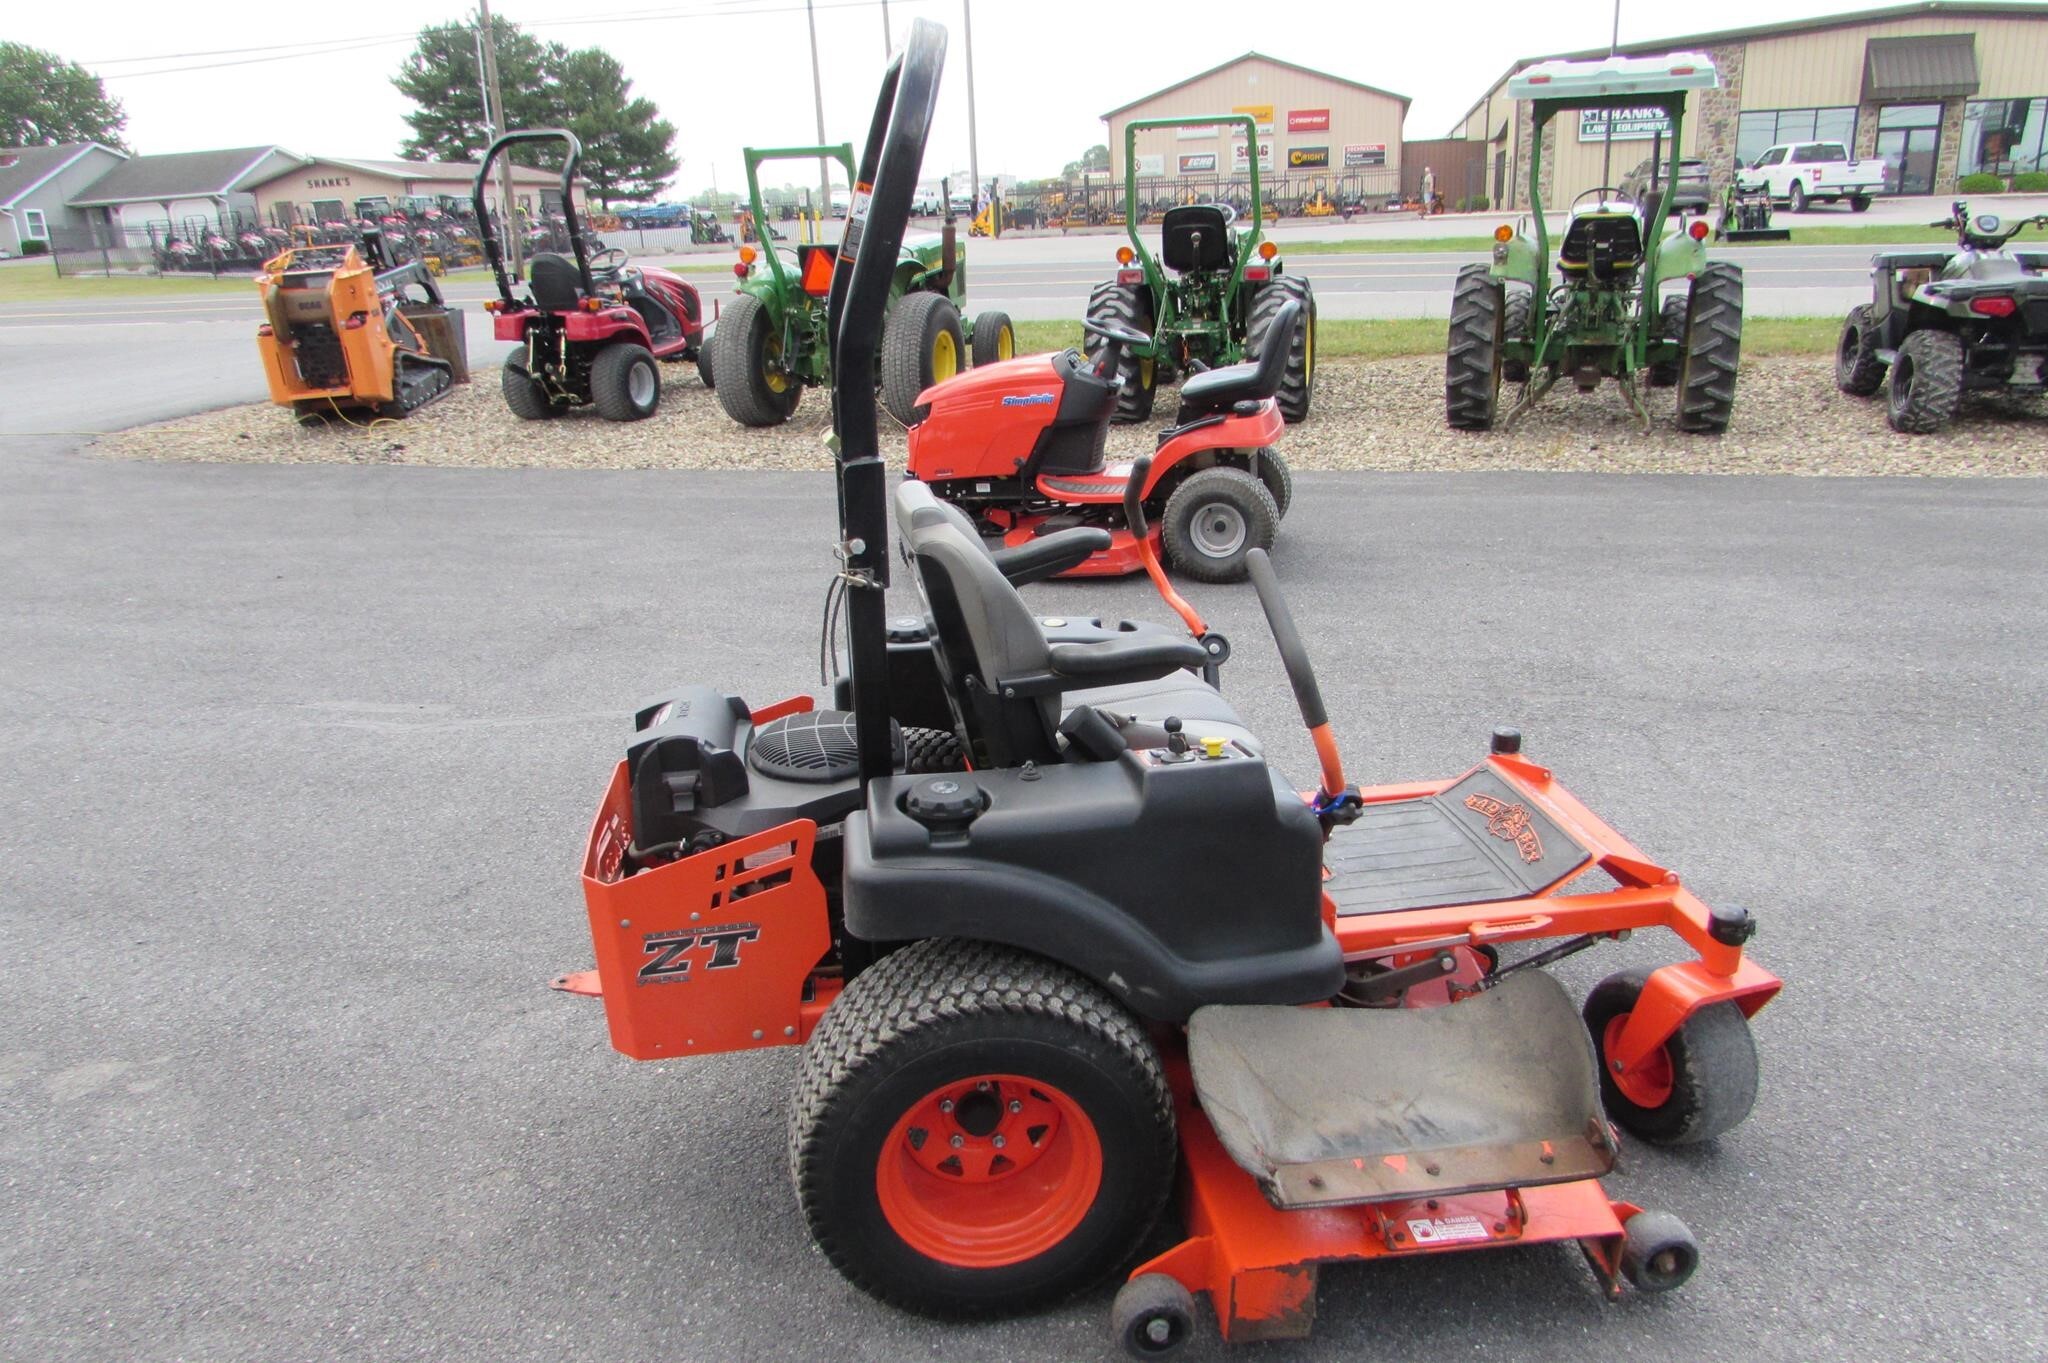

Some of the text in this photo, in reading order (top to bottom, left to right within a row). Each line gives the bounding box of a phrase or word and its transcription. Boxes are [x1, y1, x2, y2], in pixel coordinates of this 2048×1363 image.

[1601, 108, 1665, 121] SHANK'S
[1616, 121, 1669, 132] EQUIPMENT
[307, 177, 351, 189] SHANK'S
[1002, 393, 1054, 406] Simplicity
[1465, 795, 1500, 814] BAD
[1519, 832, 1541, 864] BOY
[638, 927, 761, 977] ZT
[1444, 1215, 1478, 1224] DANGER
